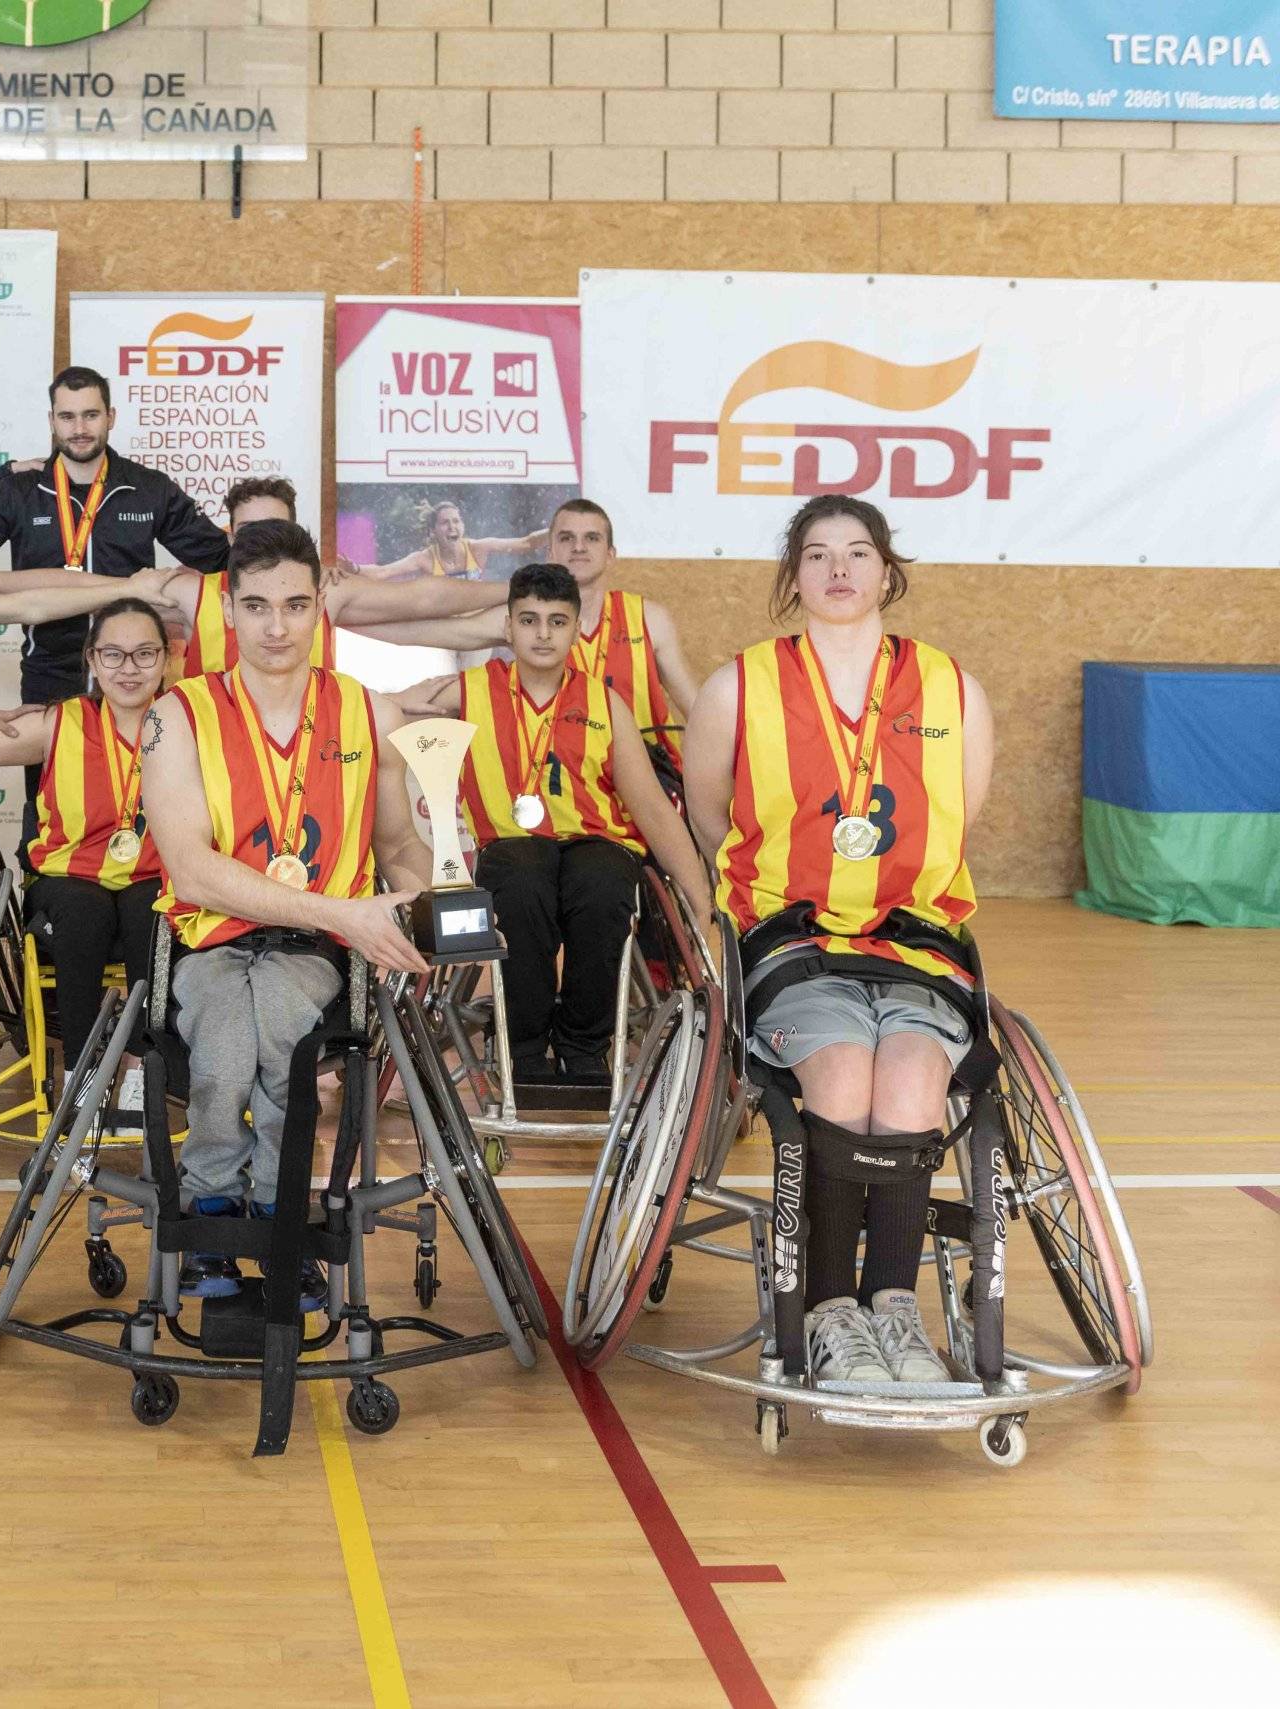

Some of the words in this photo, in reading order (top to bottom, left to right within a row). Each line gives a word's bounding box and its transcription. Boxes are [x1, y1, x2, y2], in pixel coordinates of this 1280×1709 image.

[1106, 33, 1272, 67] TERAPIA
[143, 74, 185, 97] DE
[1174, 90, 1258, 110] Villanueva
[3, 107, 45, 133] DE
[75, 107, 115, 133] LA
[142, 102, 277, 133] CAÑADA
[119, 345, 284, 377] FEDDF
[380, 381, 391, 396] la
[392, 352, 474, 396] VOZ
[128, 380, 269, 403] FEDERACIÓN
[138, 404, 259, 426] ESPAÑOLA
[379, 400, 540, 434] inclusiva
[148, 431, 265, 450] DEPORTES
[648, 420, 1051, 500] FEDDF
[908, 725, 950, 739] FCEDF
